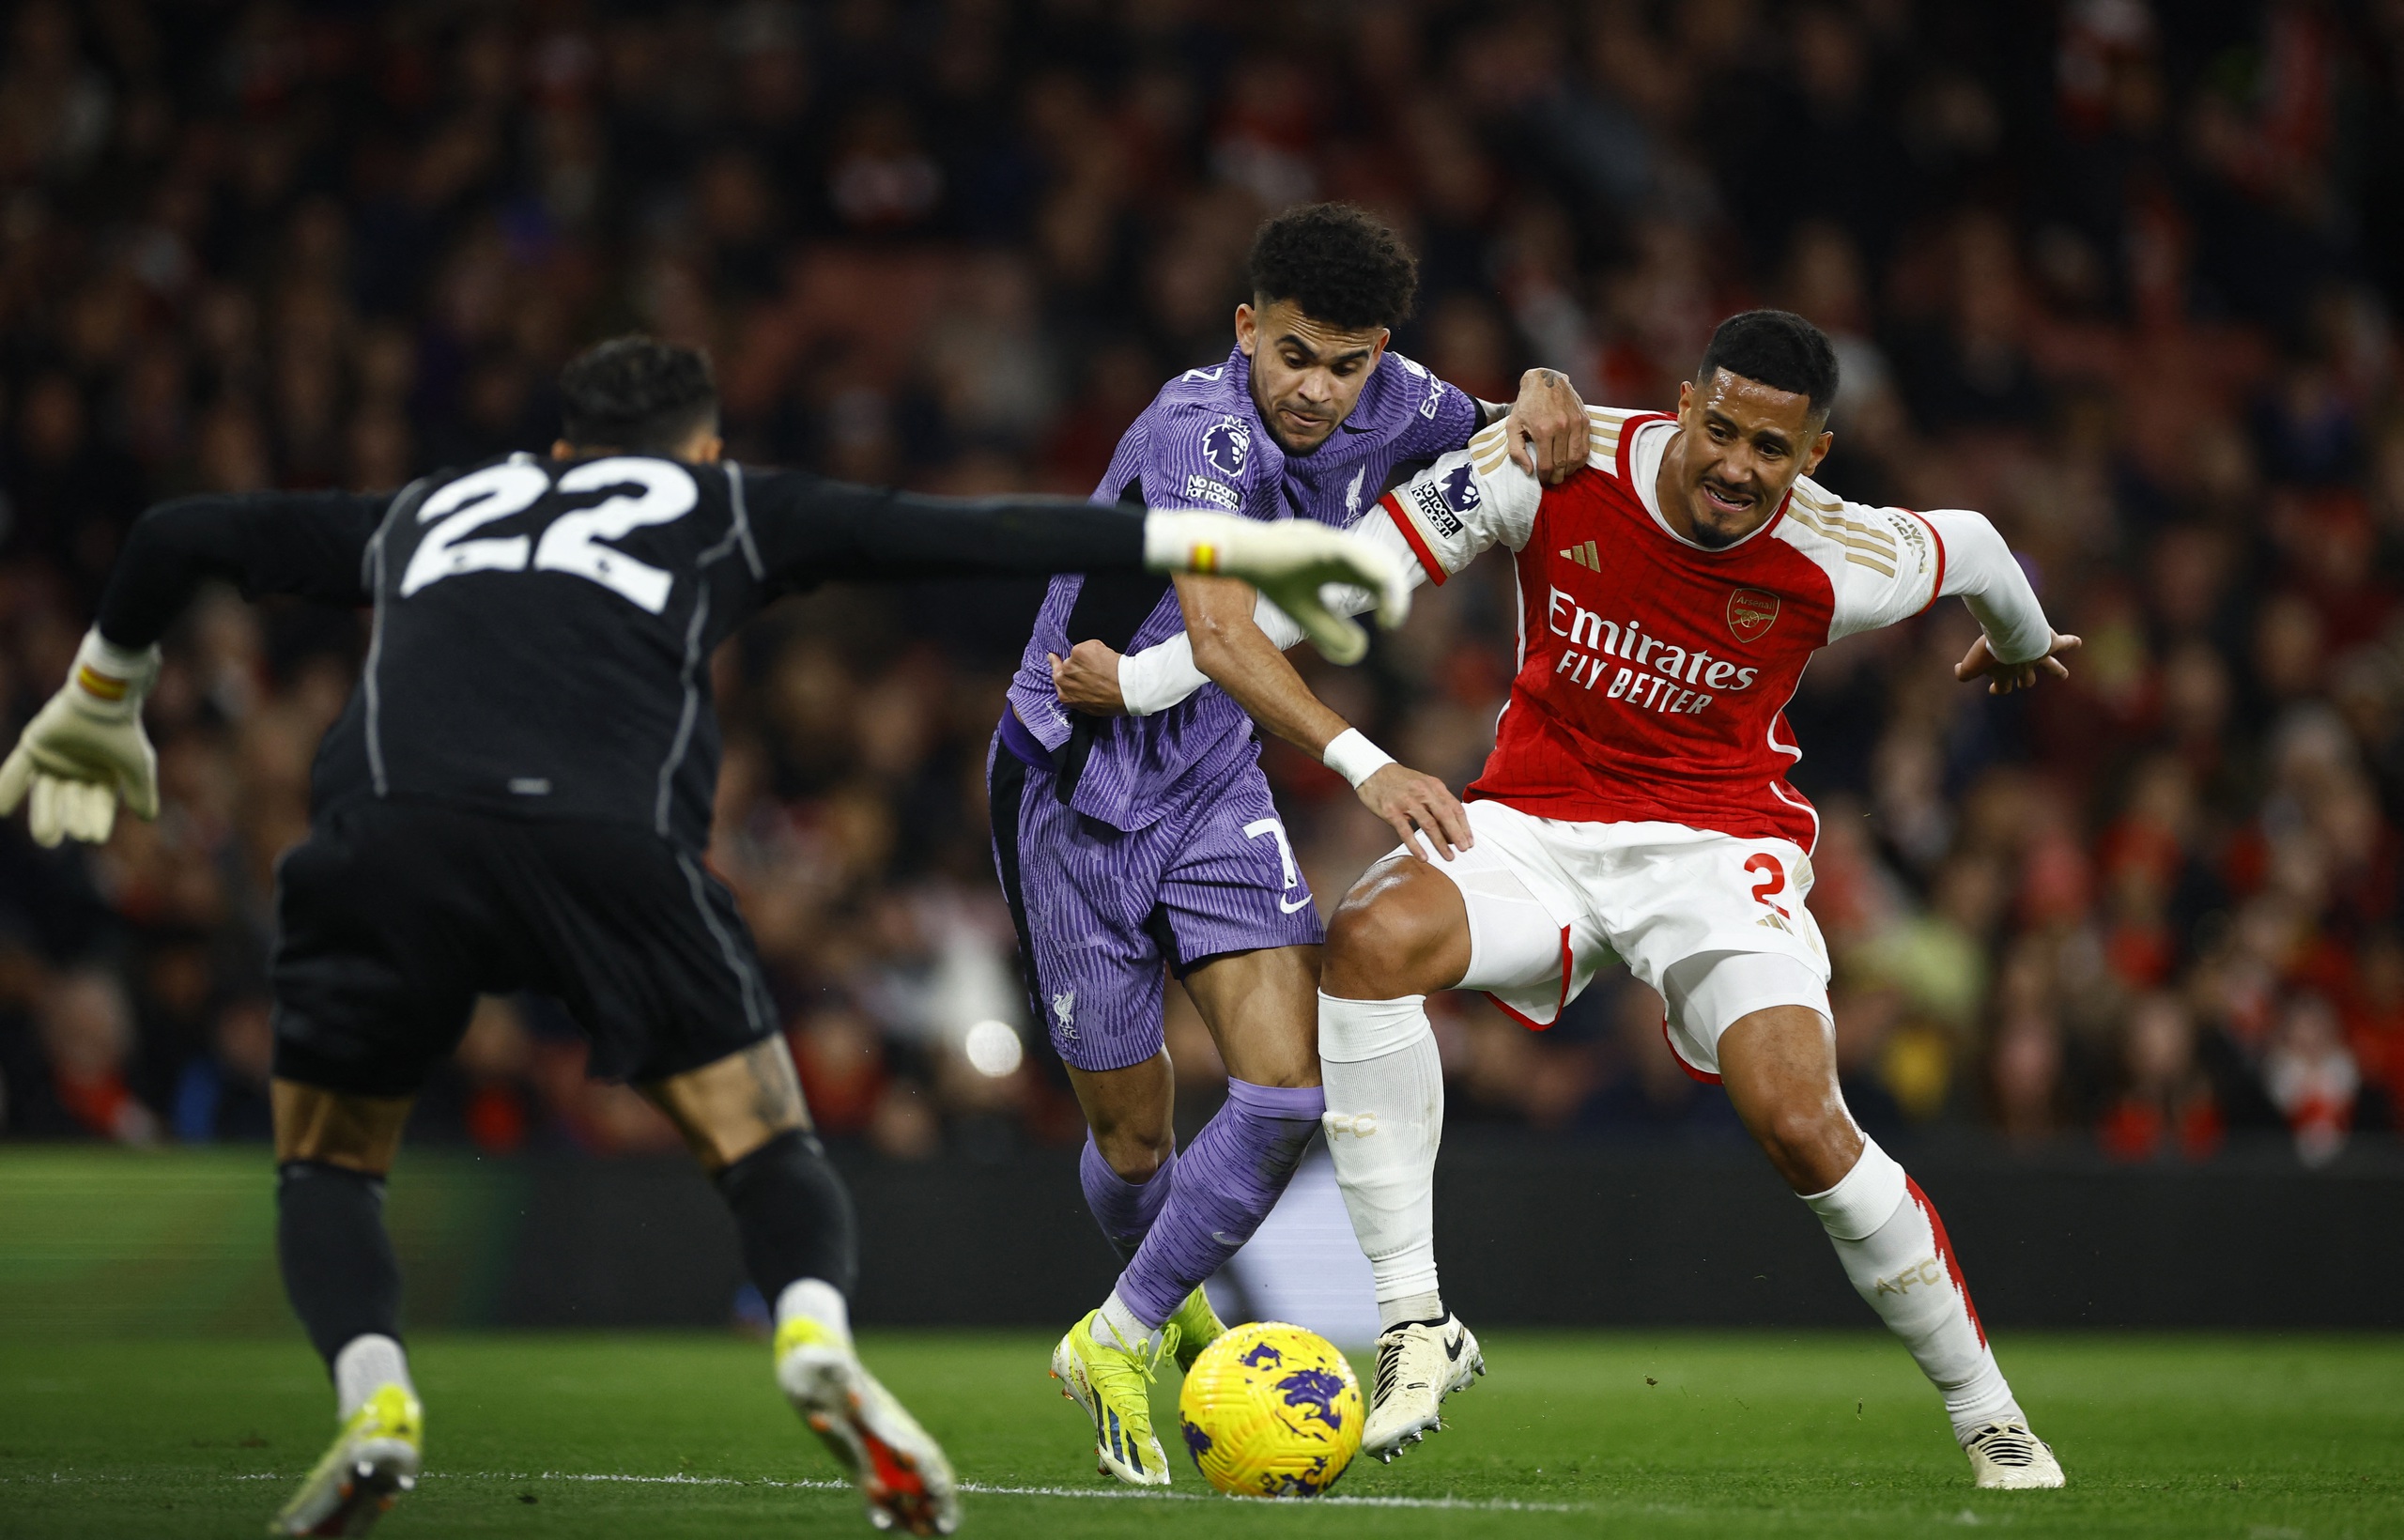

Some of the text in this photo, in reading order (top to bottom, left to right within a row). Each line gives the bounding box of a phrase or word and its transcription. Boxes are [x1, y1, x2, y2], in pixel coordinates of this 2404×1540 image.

[1185, 485, 1240, 512] for racism
[1187, 474, 1239, 503] No room
[1410, 485, 1453, 539] for racism
[1419, 480, 1457, 529] No room
[400, 455, 699, 615] 22
[1736, 595, 1775, 610] Arsenal
[1549, 583, 1759, 690] Emirates
[1555, 649, 1713, 715] FLY BETTER
[1242, 817, 1297, 889] 7
[1744, 853, 1790, 919] 2
[1874, 1257, 1941, 1297] AFC
